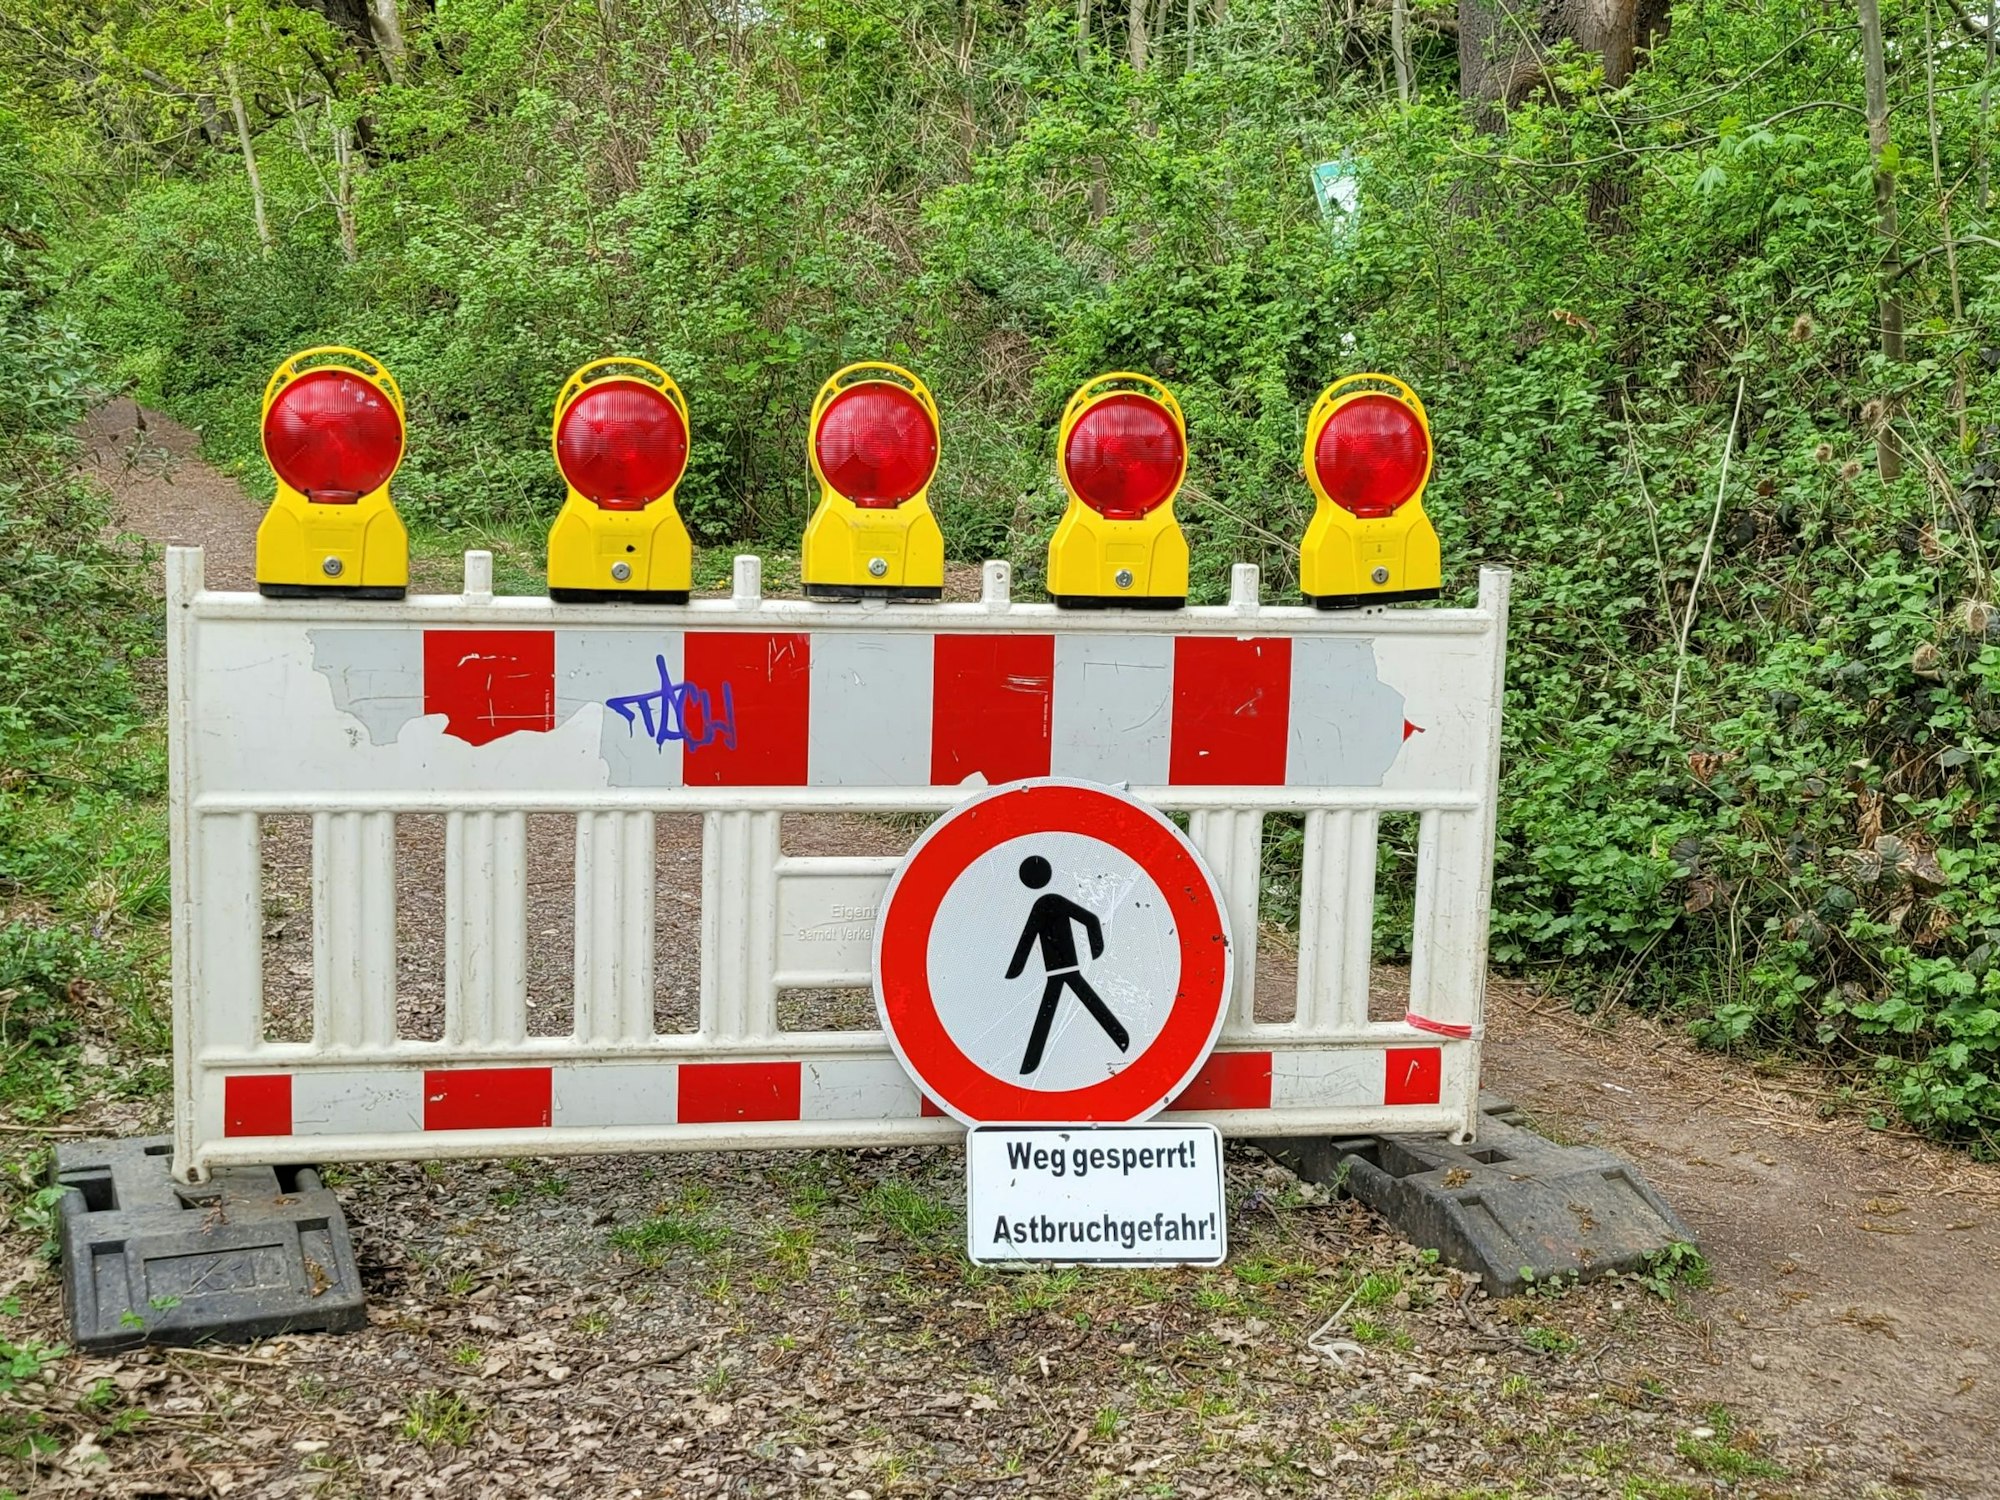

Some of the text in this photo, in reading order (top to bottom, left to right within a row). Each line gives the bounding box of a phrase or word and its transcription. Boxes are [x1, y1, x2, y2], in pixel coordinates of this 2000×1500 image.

[1006, 1140, 1196, 1177] Weg gesperrt!
[993, 1212, 1217, 1249] Astbruchgefahr!
